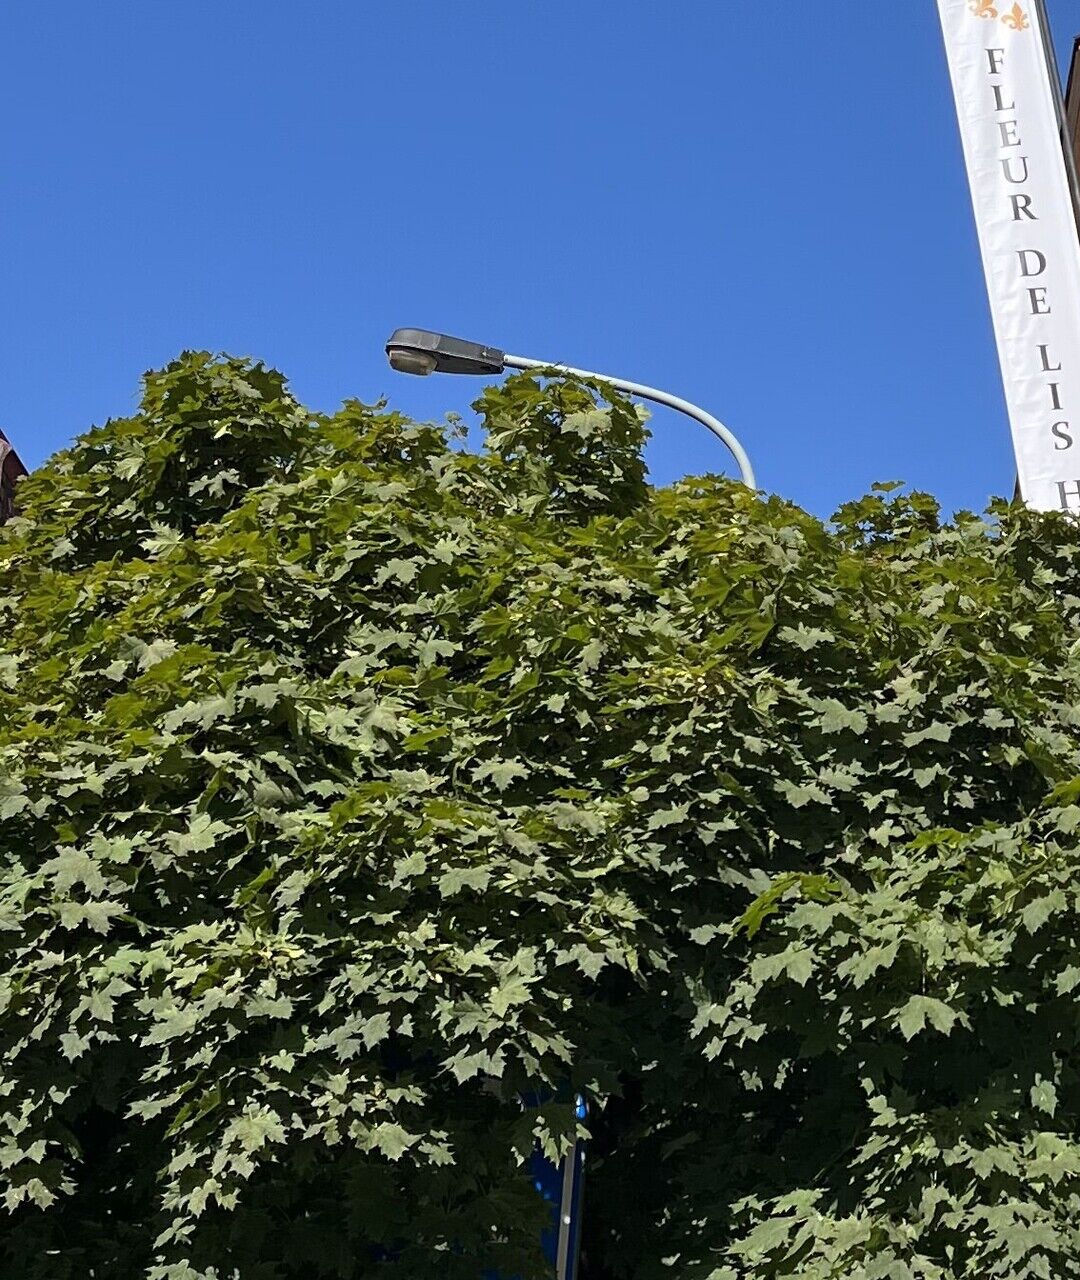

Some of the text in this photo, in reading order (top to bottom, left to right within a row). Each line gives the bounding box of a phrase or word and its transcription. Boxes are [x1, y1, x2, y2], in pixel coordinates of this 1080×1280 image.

[984, 48, 1040, 222] FLEUR
[1016, 249, 1052, 316] DE
[1039, 344, 1073, 451] LIS
